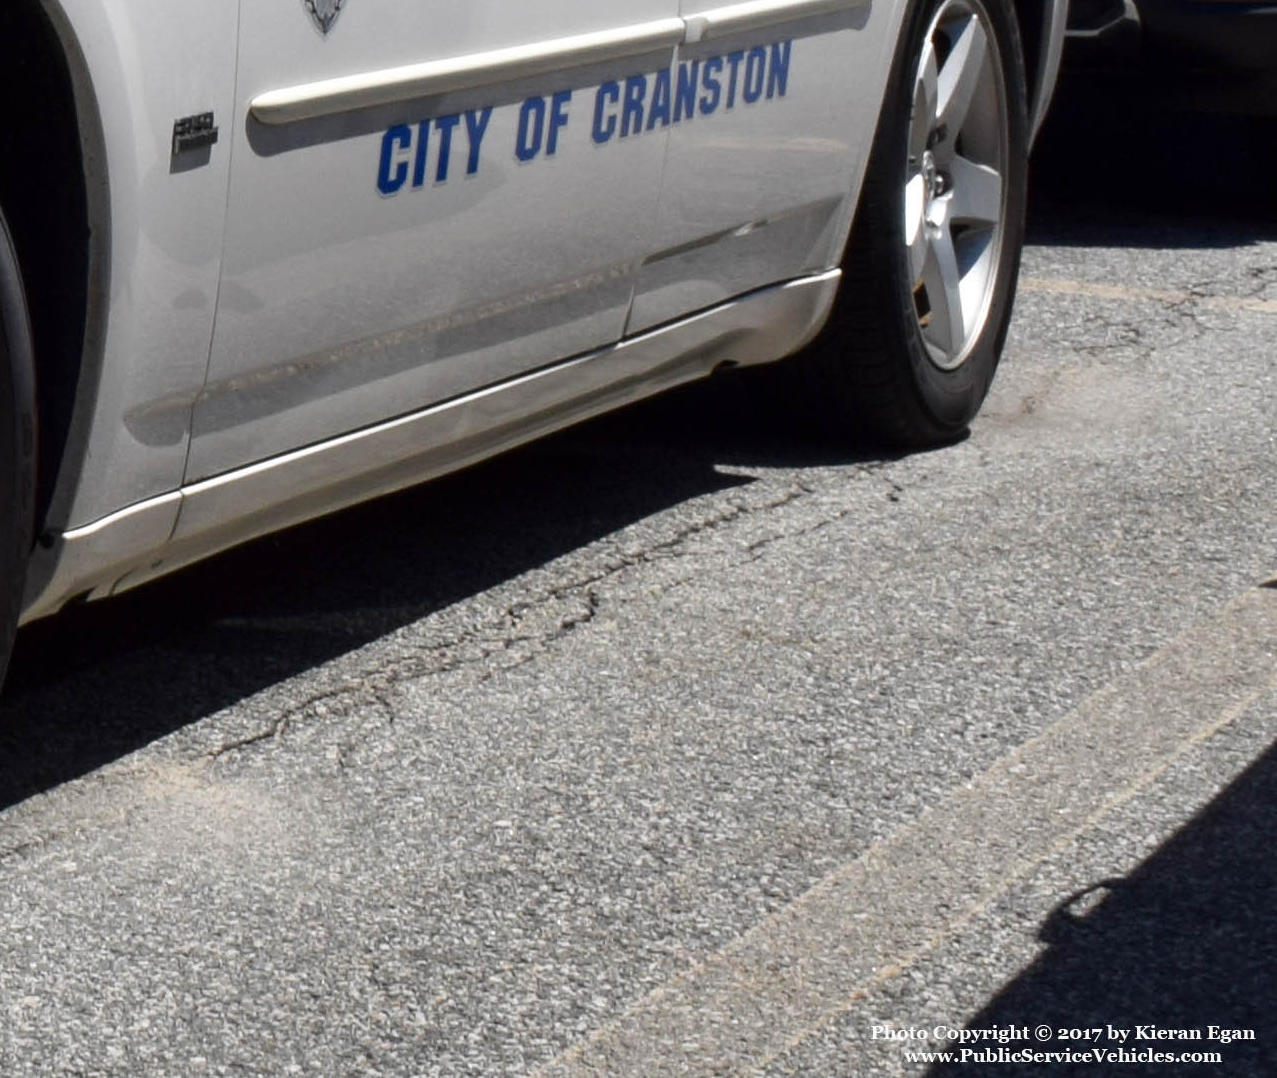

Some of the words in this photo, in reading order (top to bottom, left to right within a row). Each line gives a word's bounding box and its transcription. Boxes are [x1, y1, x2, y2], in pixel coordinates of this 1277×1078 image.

[376, 105, 494, 196] CITY
[514, 90, 574, 163] OF
[592, 39, 793, 144] CRANSTON
